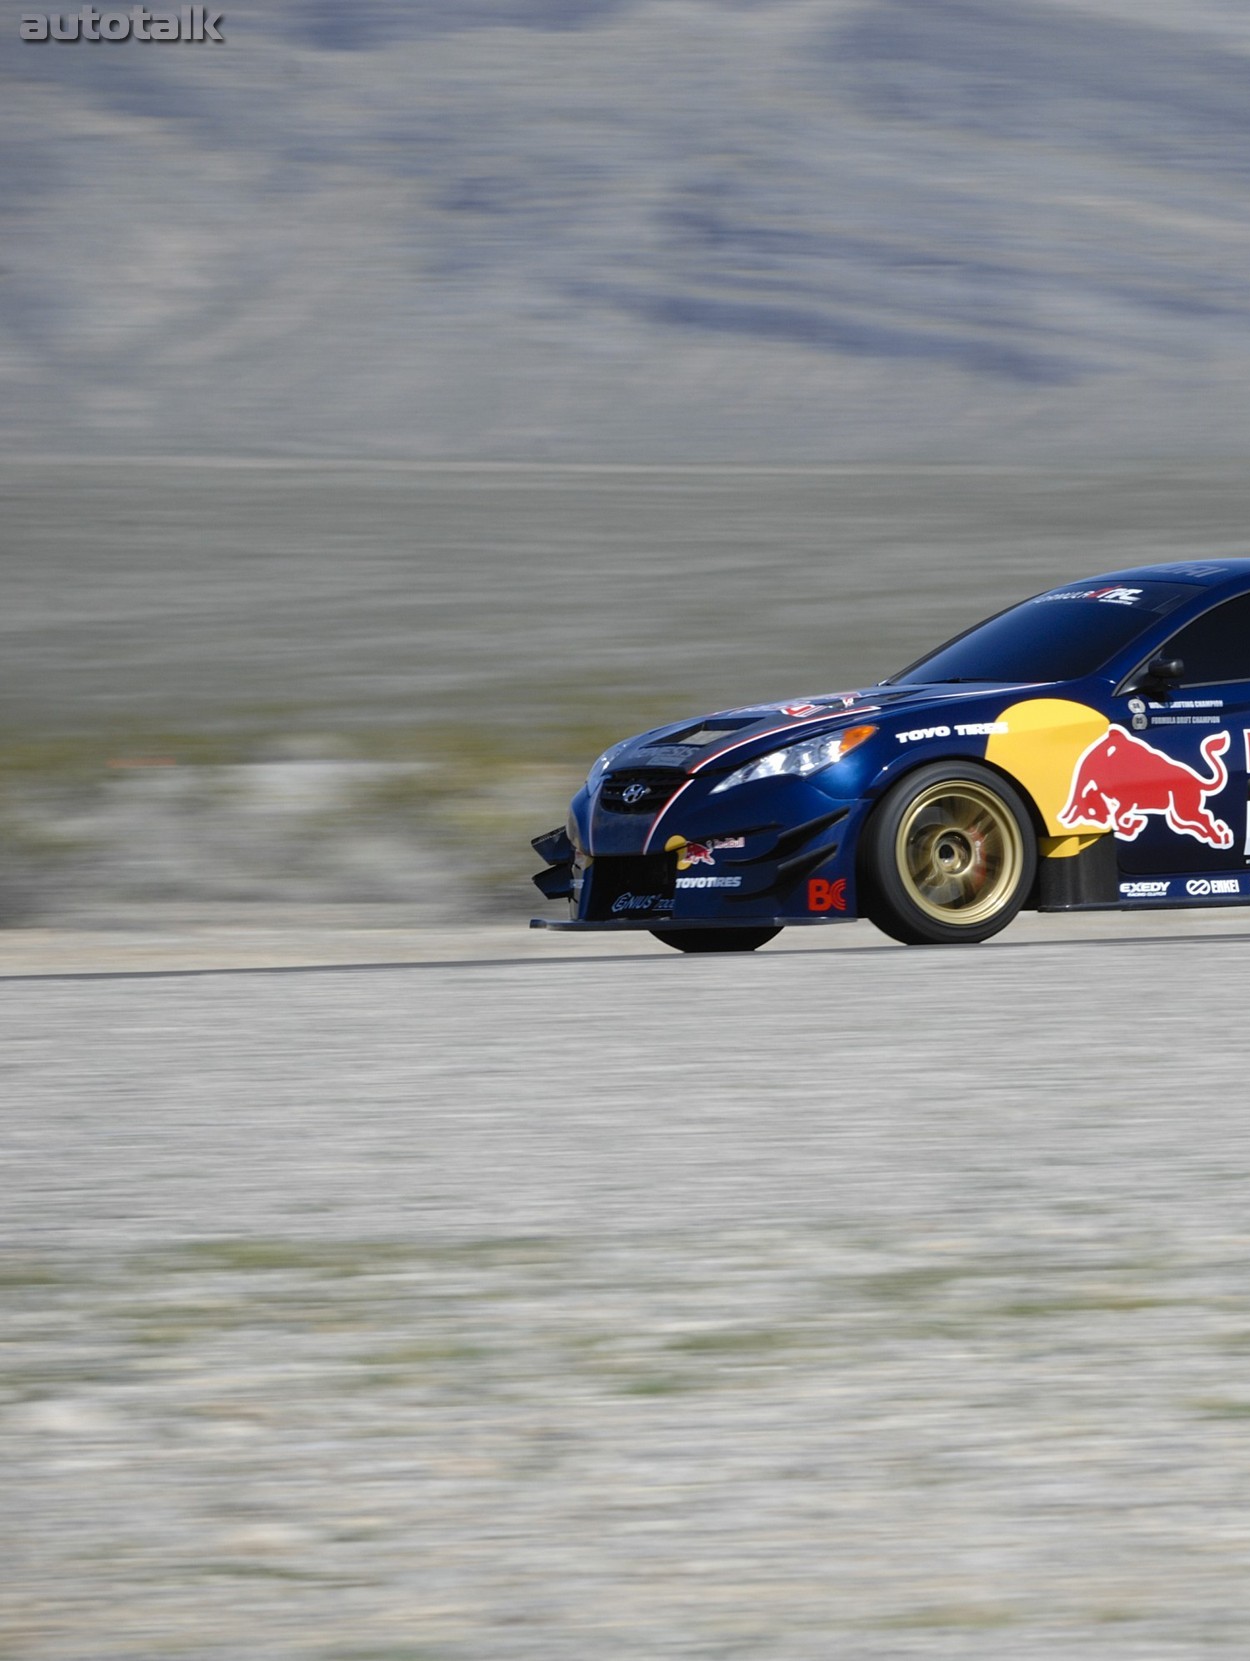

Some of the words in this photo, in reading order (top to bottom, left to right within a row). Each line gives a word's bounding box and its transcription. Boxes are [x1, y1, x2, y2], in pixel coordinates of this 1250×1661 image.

[895, 726, 951, 743] TOYO
[953, 721, 1009, 736] TIRES
[1119, 881, 1171, 893] EXEDY
